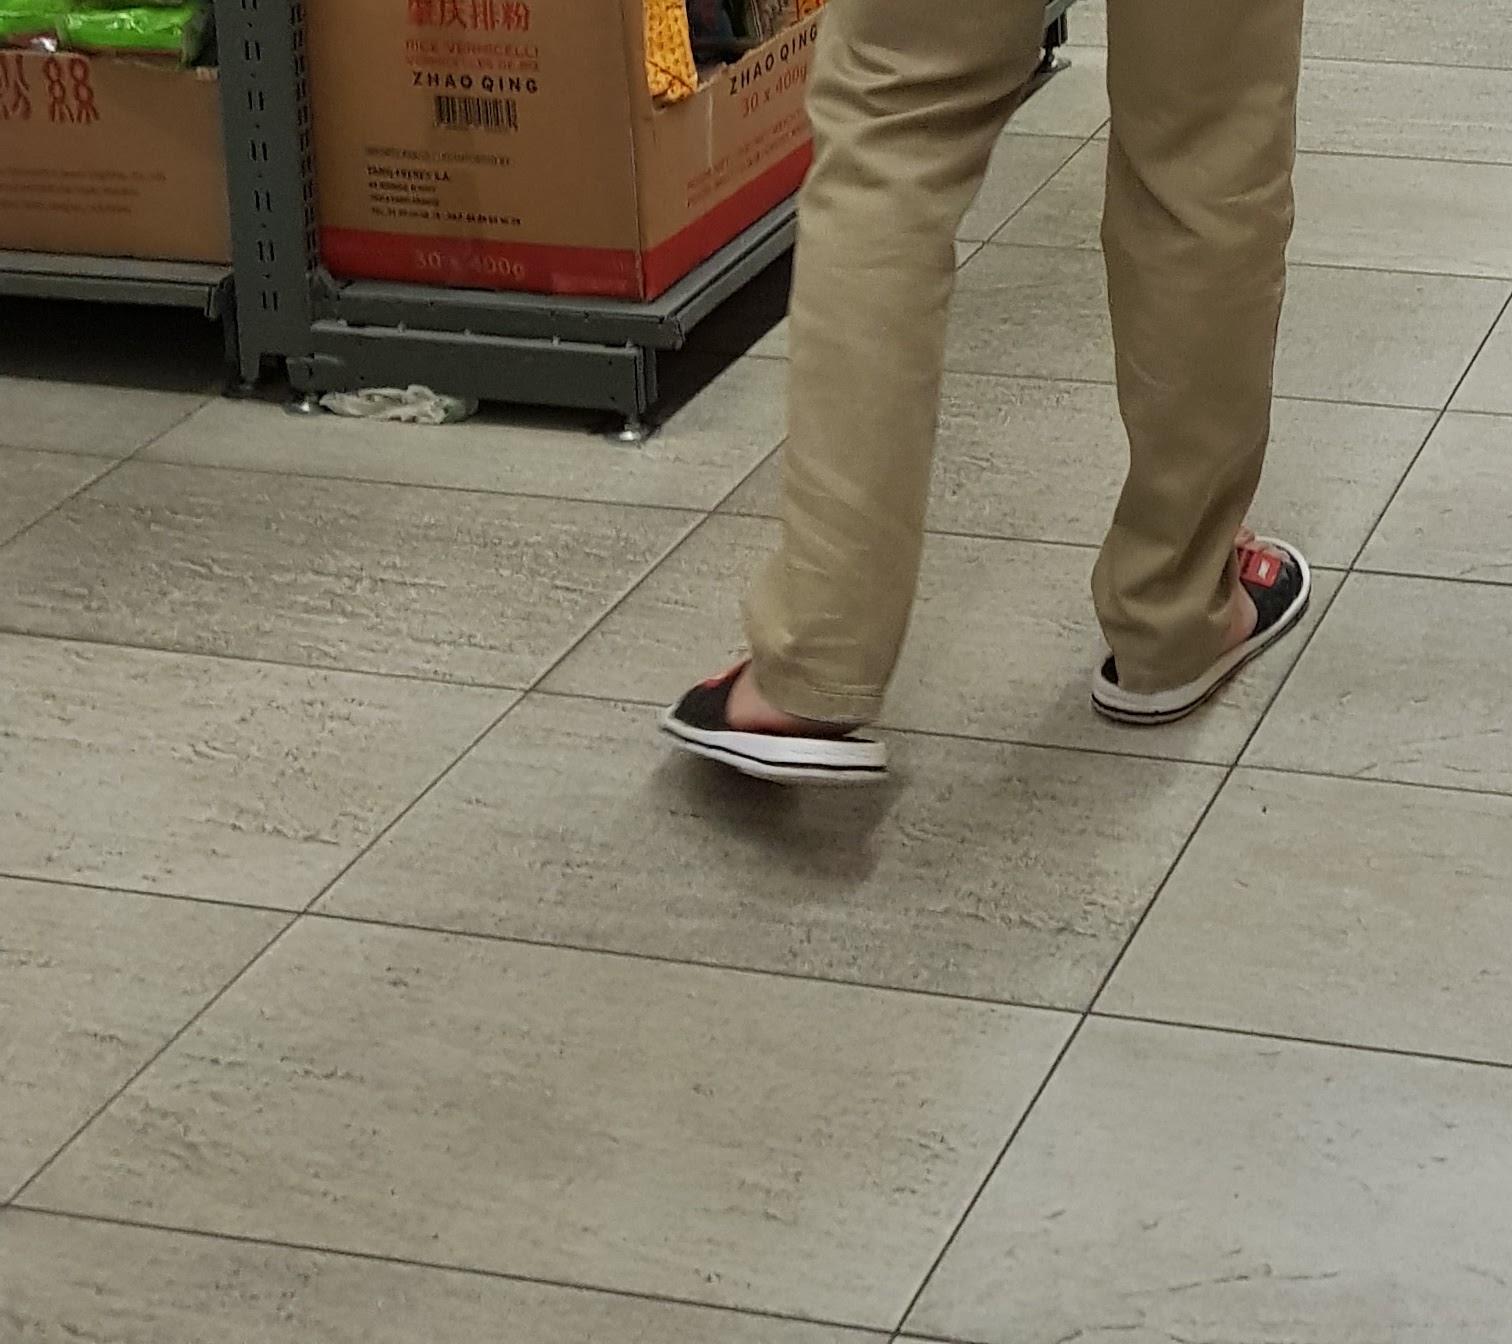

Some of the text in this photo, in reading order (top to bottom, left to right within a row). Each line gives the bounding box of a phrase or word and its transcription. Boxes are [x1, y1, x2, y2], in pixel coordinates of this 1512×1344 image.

[412, 70, 539, 94] ZHAO QING
[730, 24, 818, 96] ZHAO QING
